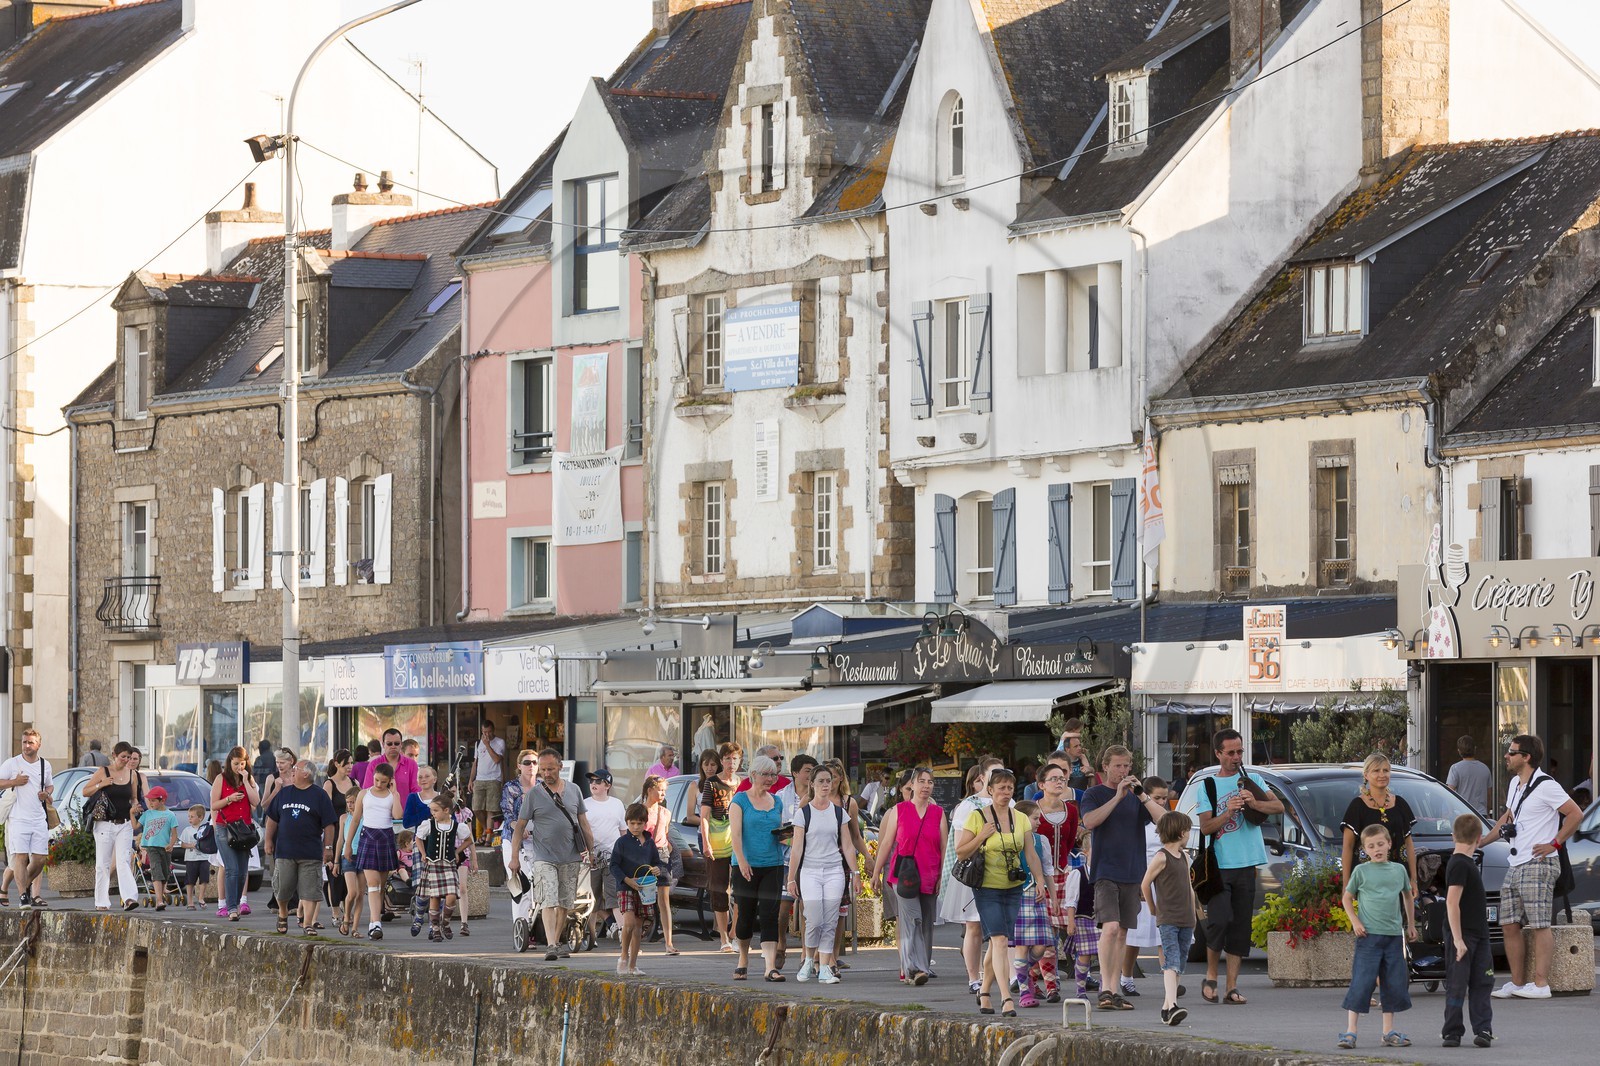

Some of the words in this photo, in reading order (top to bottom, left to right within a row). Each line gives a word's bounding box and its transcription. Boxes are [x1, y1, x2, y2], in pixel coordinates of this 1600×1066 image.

[740, 306, 798, 319] PROCHAINEMENT
[746, 323, 786, 341] VENDRE
[1472, 574, 1555, 621] Crêperie
[1567, 569, 1595, 621] Ty
[519, 652, 542, 670] Vent
[927, 626, 952, 669] Le
[953, 623, 984, 677] Quai
[1016, 646, 1064, 677] Bistrot
[177, 647, 219, 680] TBS
[680, 656, 697, 680] DE
[698, 655, 746, 679] MISAINE
[834, 653, 899, 683] Restaurant
[1249, 648, 1281, 680] 56
[408, 668, 419, 689] la
[517, 675, 550, 694] directe
[329, 684, 358, 701] directe
